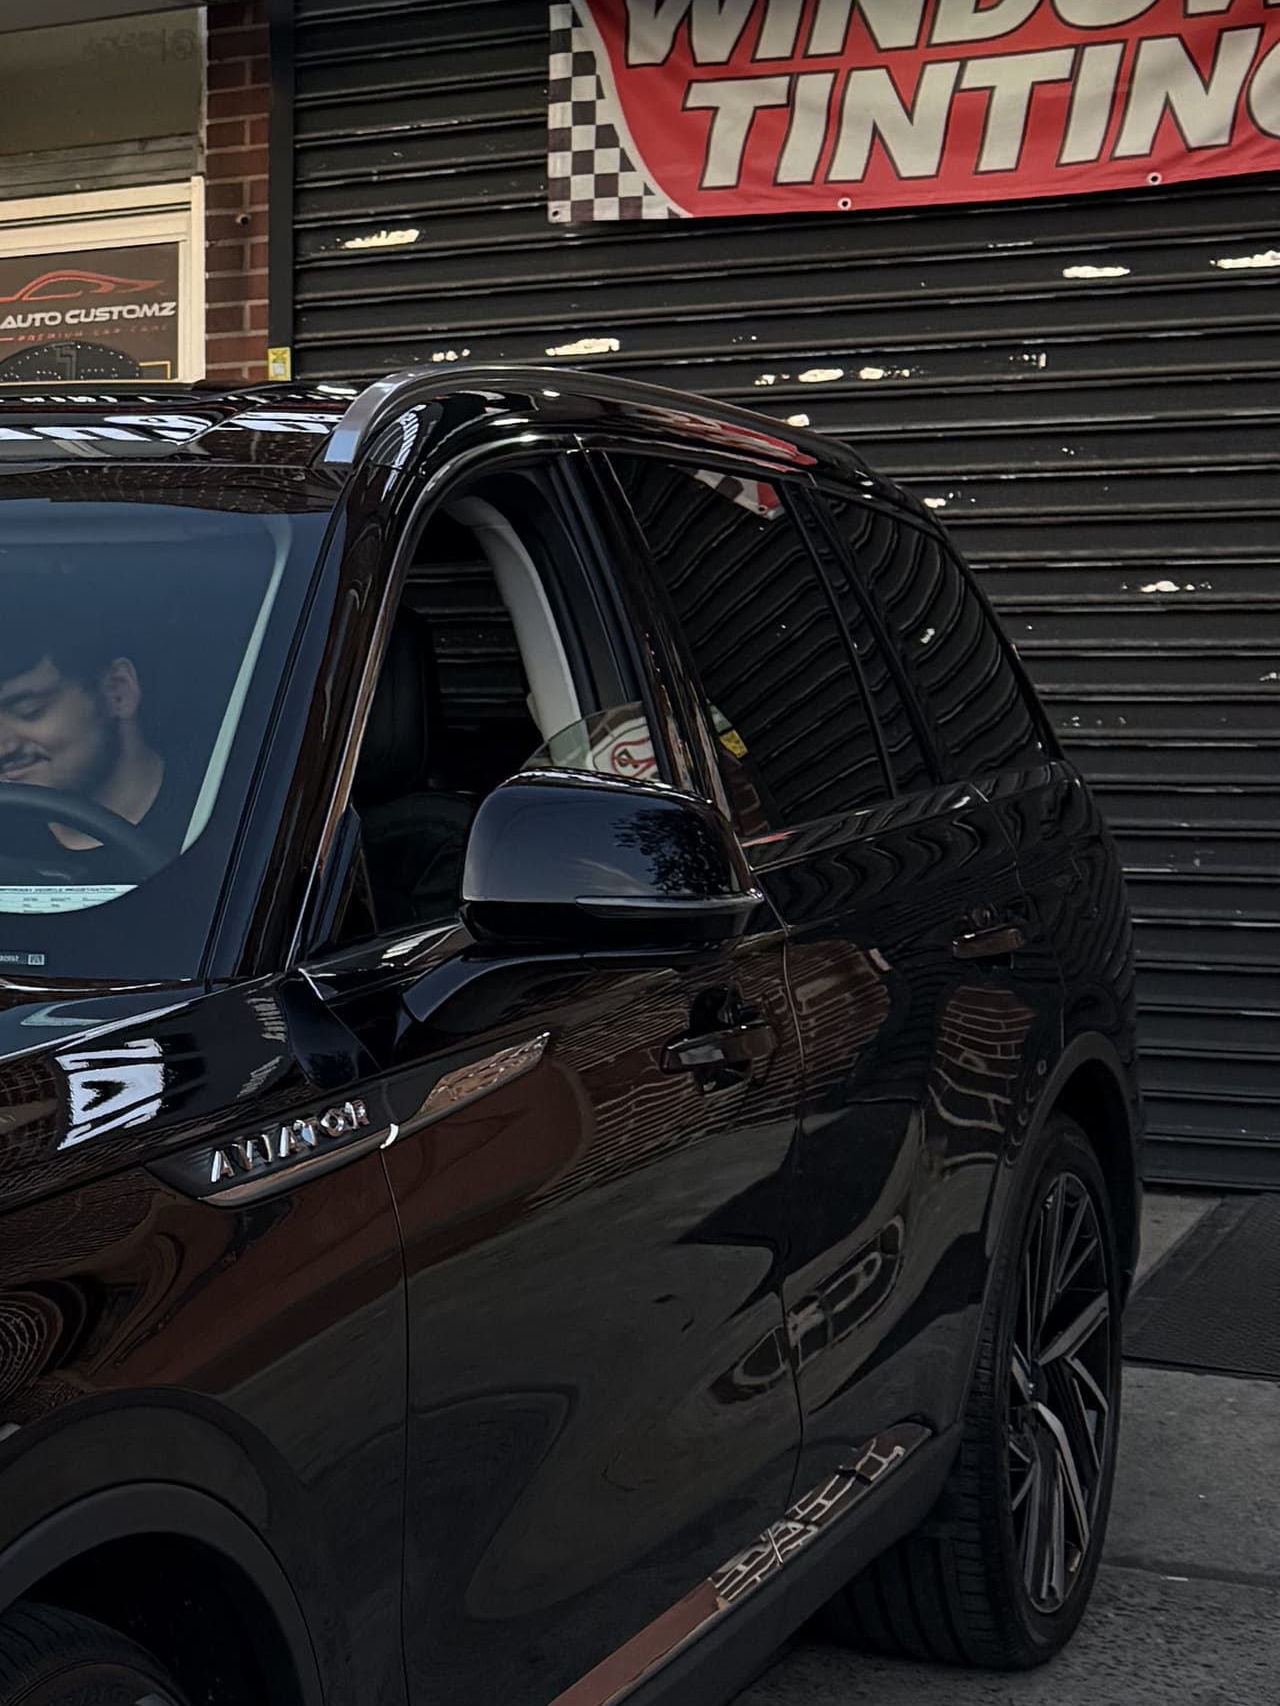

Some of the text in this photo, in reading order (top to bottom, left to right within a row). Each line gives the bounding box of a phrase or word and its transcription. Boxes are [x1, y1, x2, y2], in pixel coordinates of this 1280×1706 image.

[682, 26, 1280, 191] TINTIN
[64, 301, 178, 324] CUSTOMZ
[210, 1099, 371, 1182] AVIATOR
